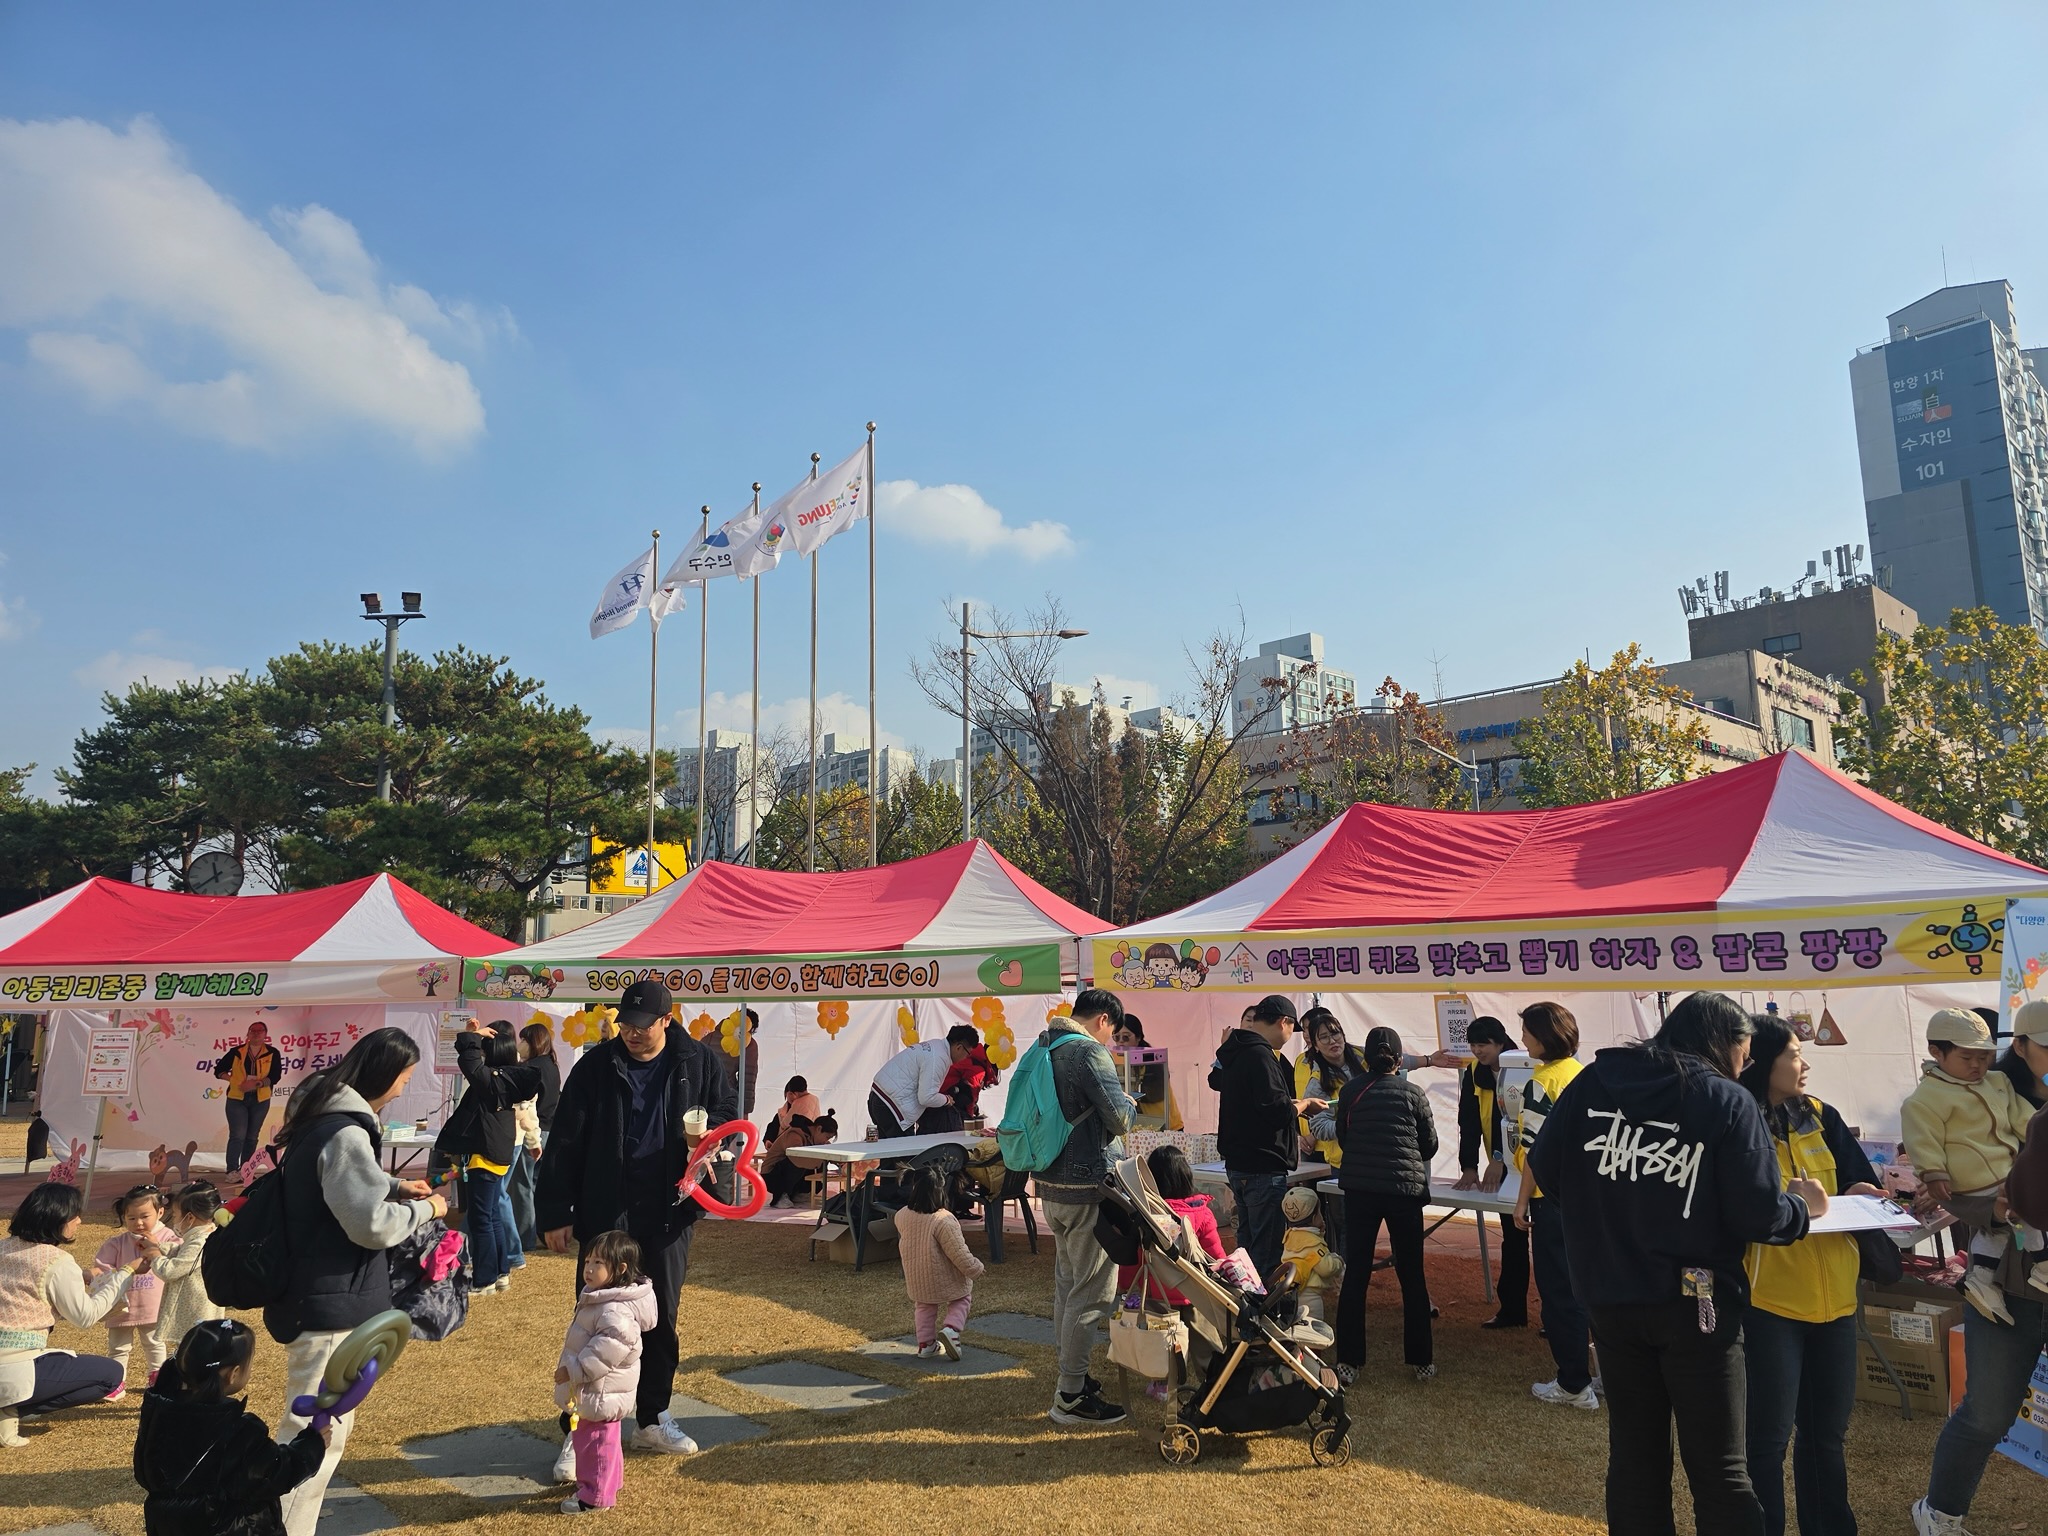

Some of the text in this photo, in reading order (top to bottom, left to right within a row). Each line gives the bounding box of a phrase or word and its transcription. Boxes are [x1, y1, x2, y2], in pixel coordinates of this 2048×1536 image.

[1893, 368, 1945, 393] 한양 1차
[1897, 411, 1924, 423] SUJAIN
[1901, 427, 1952, 452] 수자인
[1915, 460, 1945, 481] 101
[1229, 952, 1250, 971] 가족
[1267, 927, 1888, 979] 아동권리 퀴즈 맞추고 뽑기 하자 & 팝콘 팡팡
[1230, 966, 1254, 984] 센터
[2, 973, 268, 1002] 아동권리존중 함께해요!
[280, 1031, 341, 1052] 안아주고
